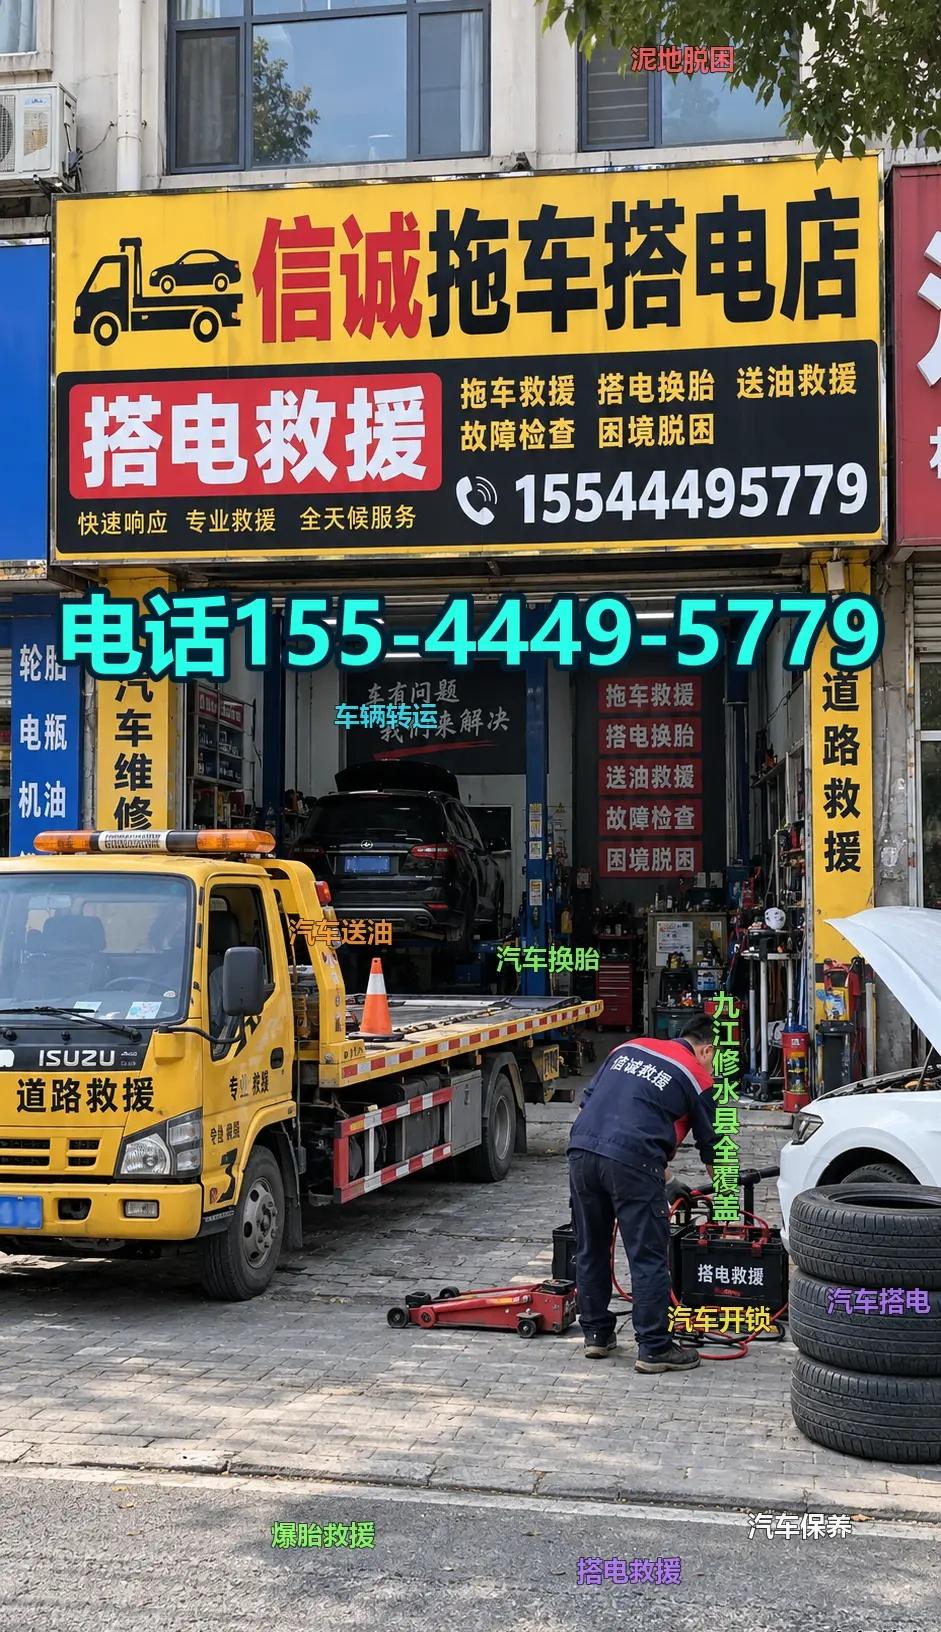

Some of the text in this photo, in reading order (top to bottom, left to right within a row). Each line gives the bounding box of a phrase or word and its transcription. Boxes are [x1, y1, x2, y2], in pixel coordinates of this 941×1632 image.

[253, 187, 860, 343] 信诚拖车搭电店
[460, 362, 857, 410] 拖车救援 搭电换胎 送油救援
[82, 385, 427, 489] 搭电救援
[460, 413, 715, 453] 故障检查 困境脱困
[515, 461, 868, 524] 15544495779
[78, 504, 416, 537] 快速响应 专业救援 全天候服务
[20, 643, 67, 682] 轮胎
[365, 679, 460, 706] 车有问题
[605, 682, 695, 708] 拖车救援
[20, 713, 67, 751] 电瓶
[605, 723, 695, 749] 搭电换胎
[605, 764, 695, 790] 送油救援
[822, 671, 862, 873] 道路救援
[18, 780, 66, 818] 机油
[606, 805, 695, 831] 故障检查
[606, 847, 695, 873] 困境脱困
[39, 1050, 115, 1067] ISUZU
[610, 1055, 672, 1091] 信诚救援
[17, 1077, 154, 1113] 道路救援
[698, 1263, 764, 1286] 搭电救援
